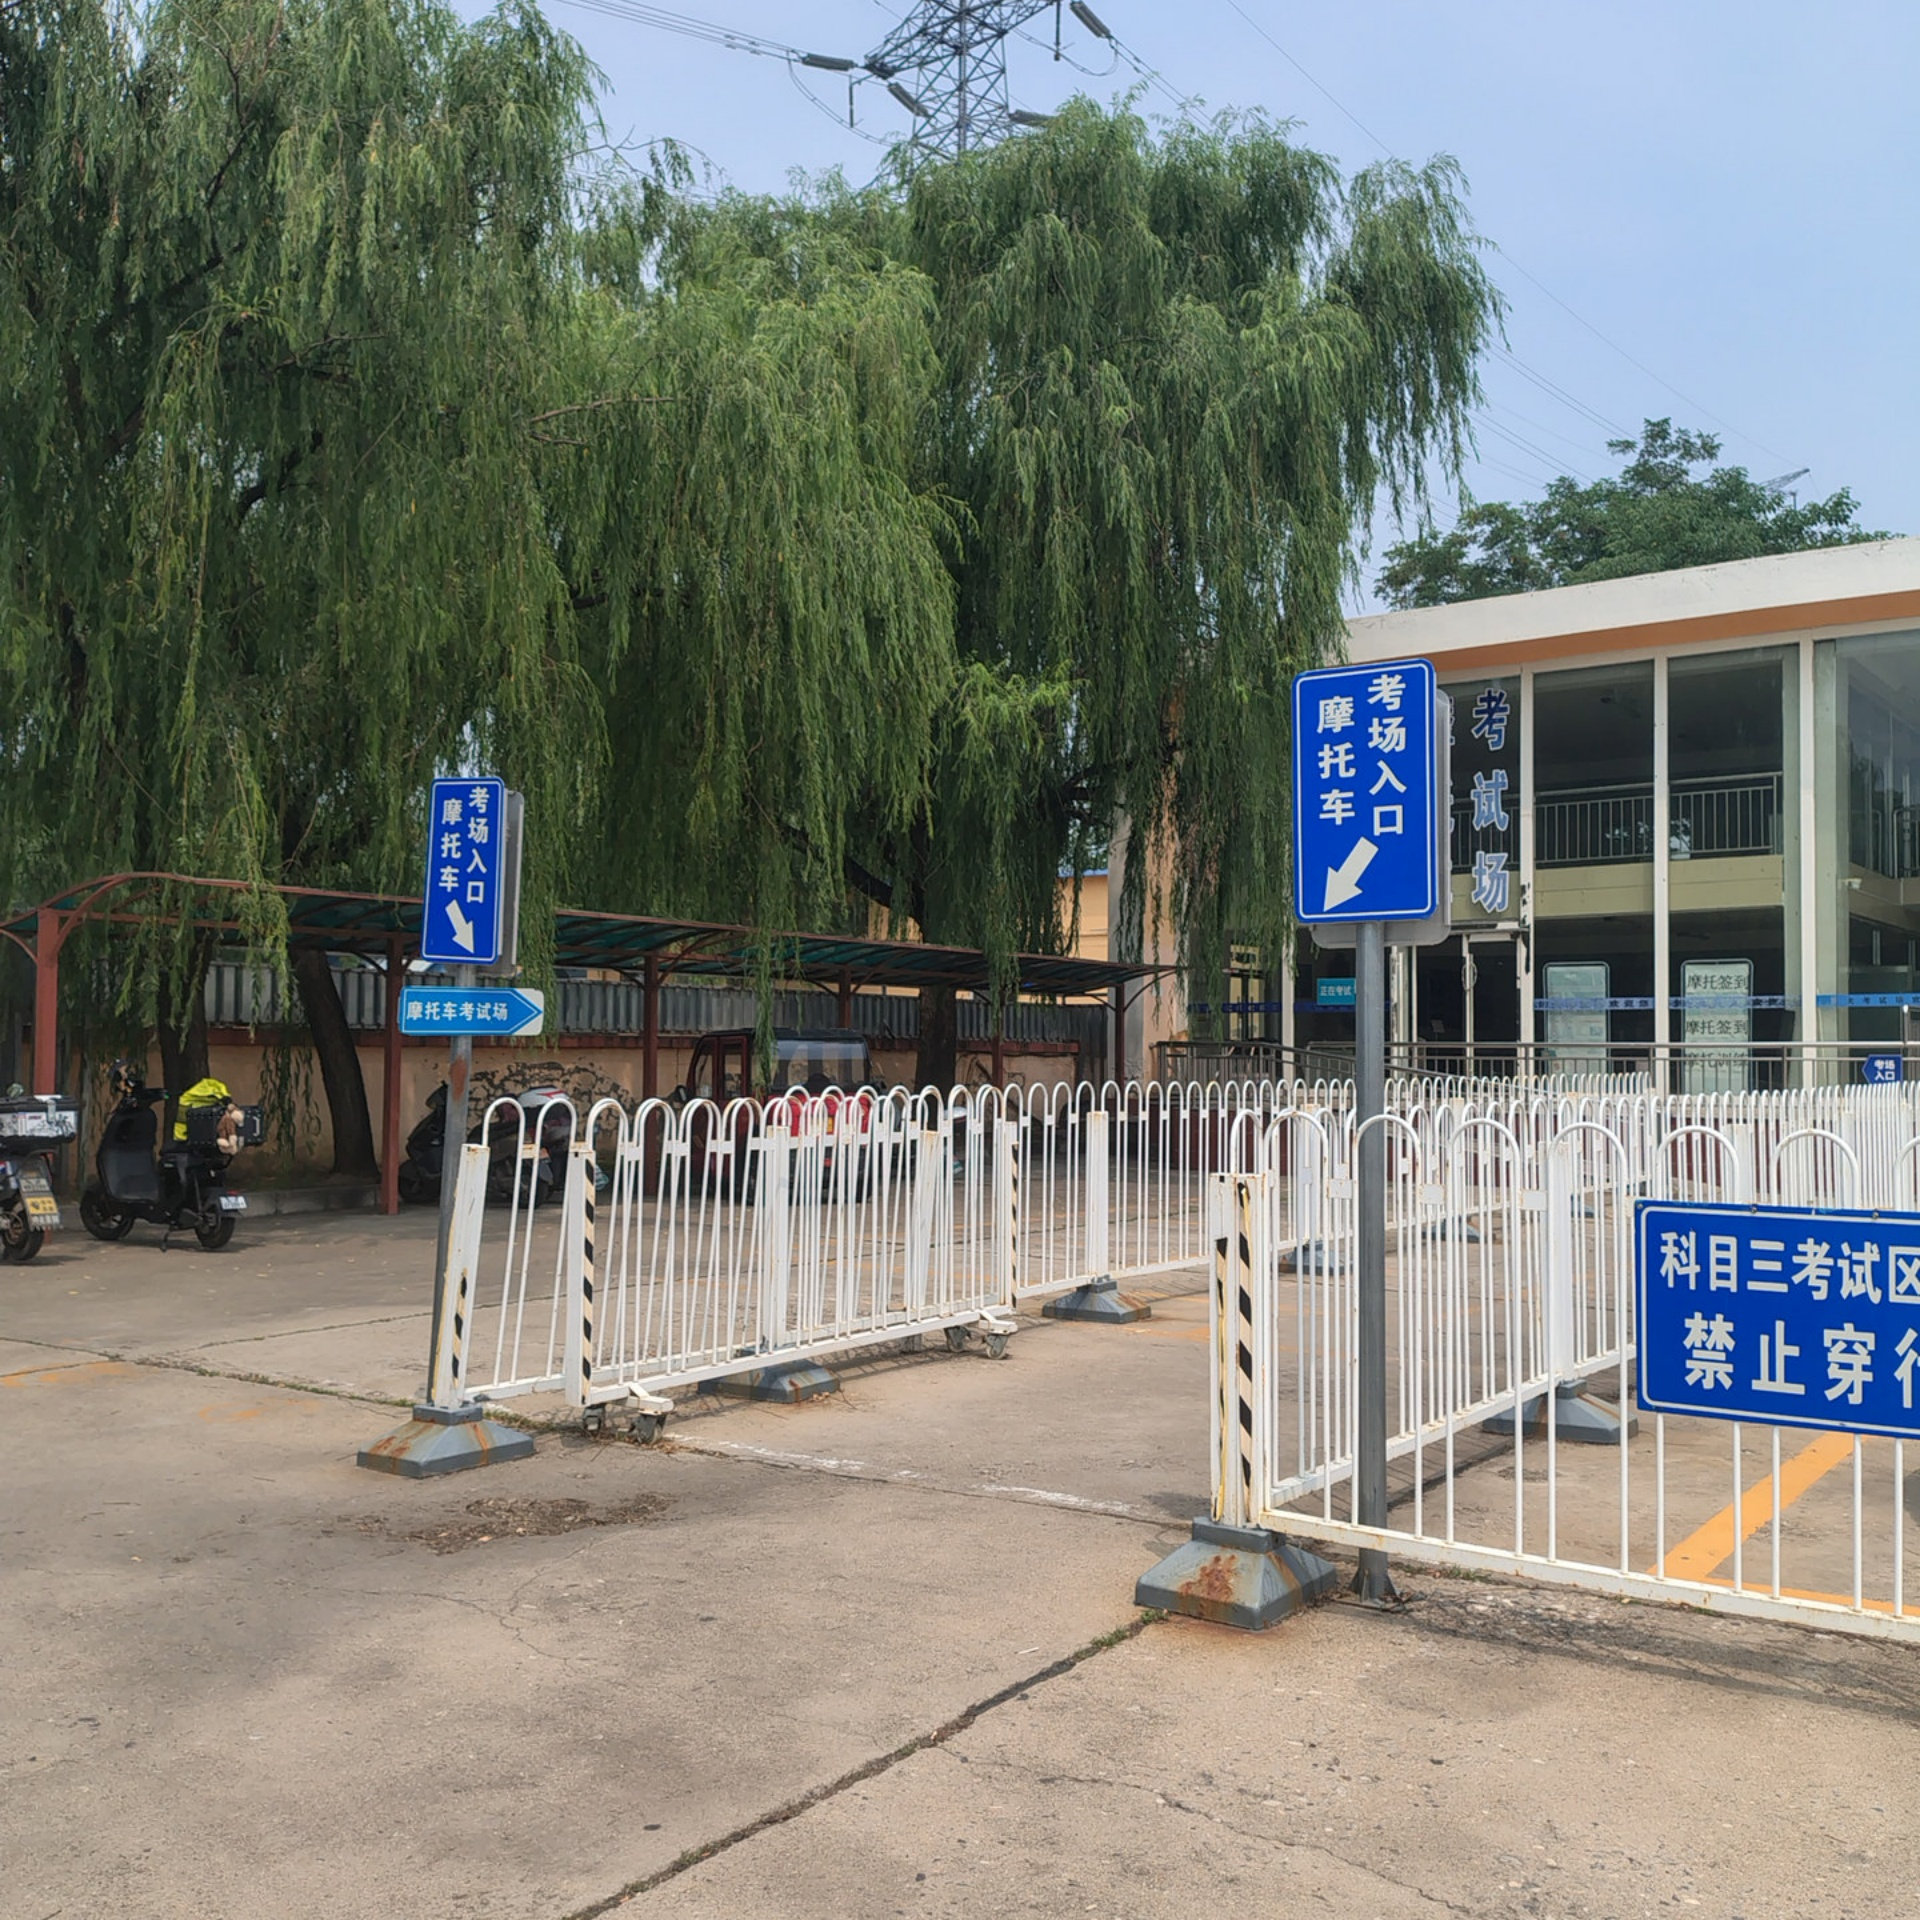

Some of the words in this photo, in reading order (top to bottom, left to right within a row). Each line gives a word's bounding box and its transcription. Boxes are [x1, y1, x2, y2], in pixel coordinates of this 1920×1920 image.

[1316, 696, 1356, 826] 摩托车
[1367, 674, 1407, 836] 考场入口
[1471, 687, 1510, 914] 考试场
[438, 798, 463, 893] 摩托车
[466, 786, 490, 904] 考场入口
[406, 1000, 509, 1022] 摩托车考试场
[1686, 974, 1749, 990] 摩托签到
[1685, 1019, 1749, 1035] 摩托签到
[1874, 1071, 1896, 1081] 入口
[1659, 1229, 1920, 1305] 科目三考试区
